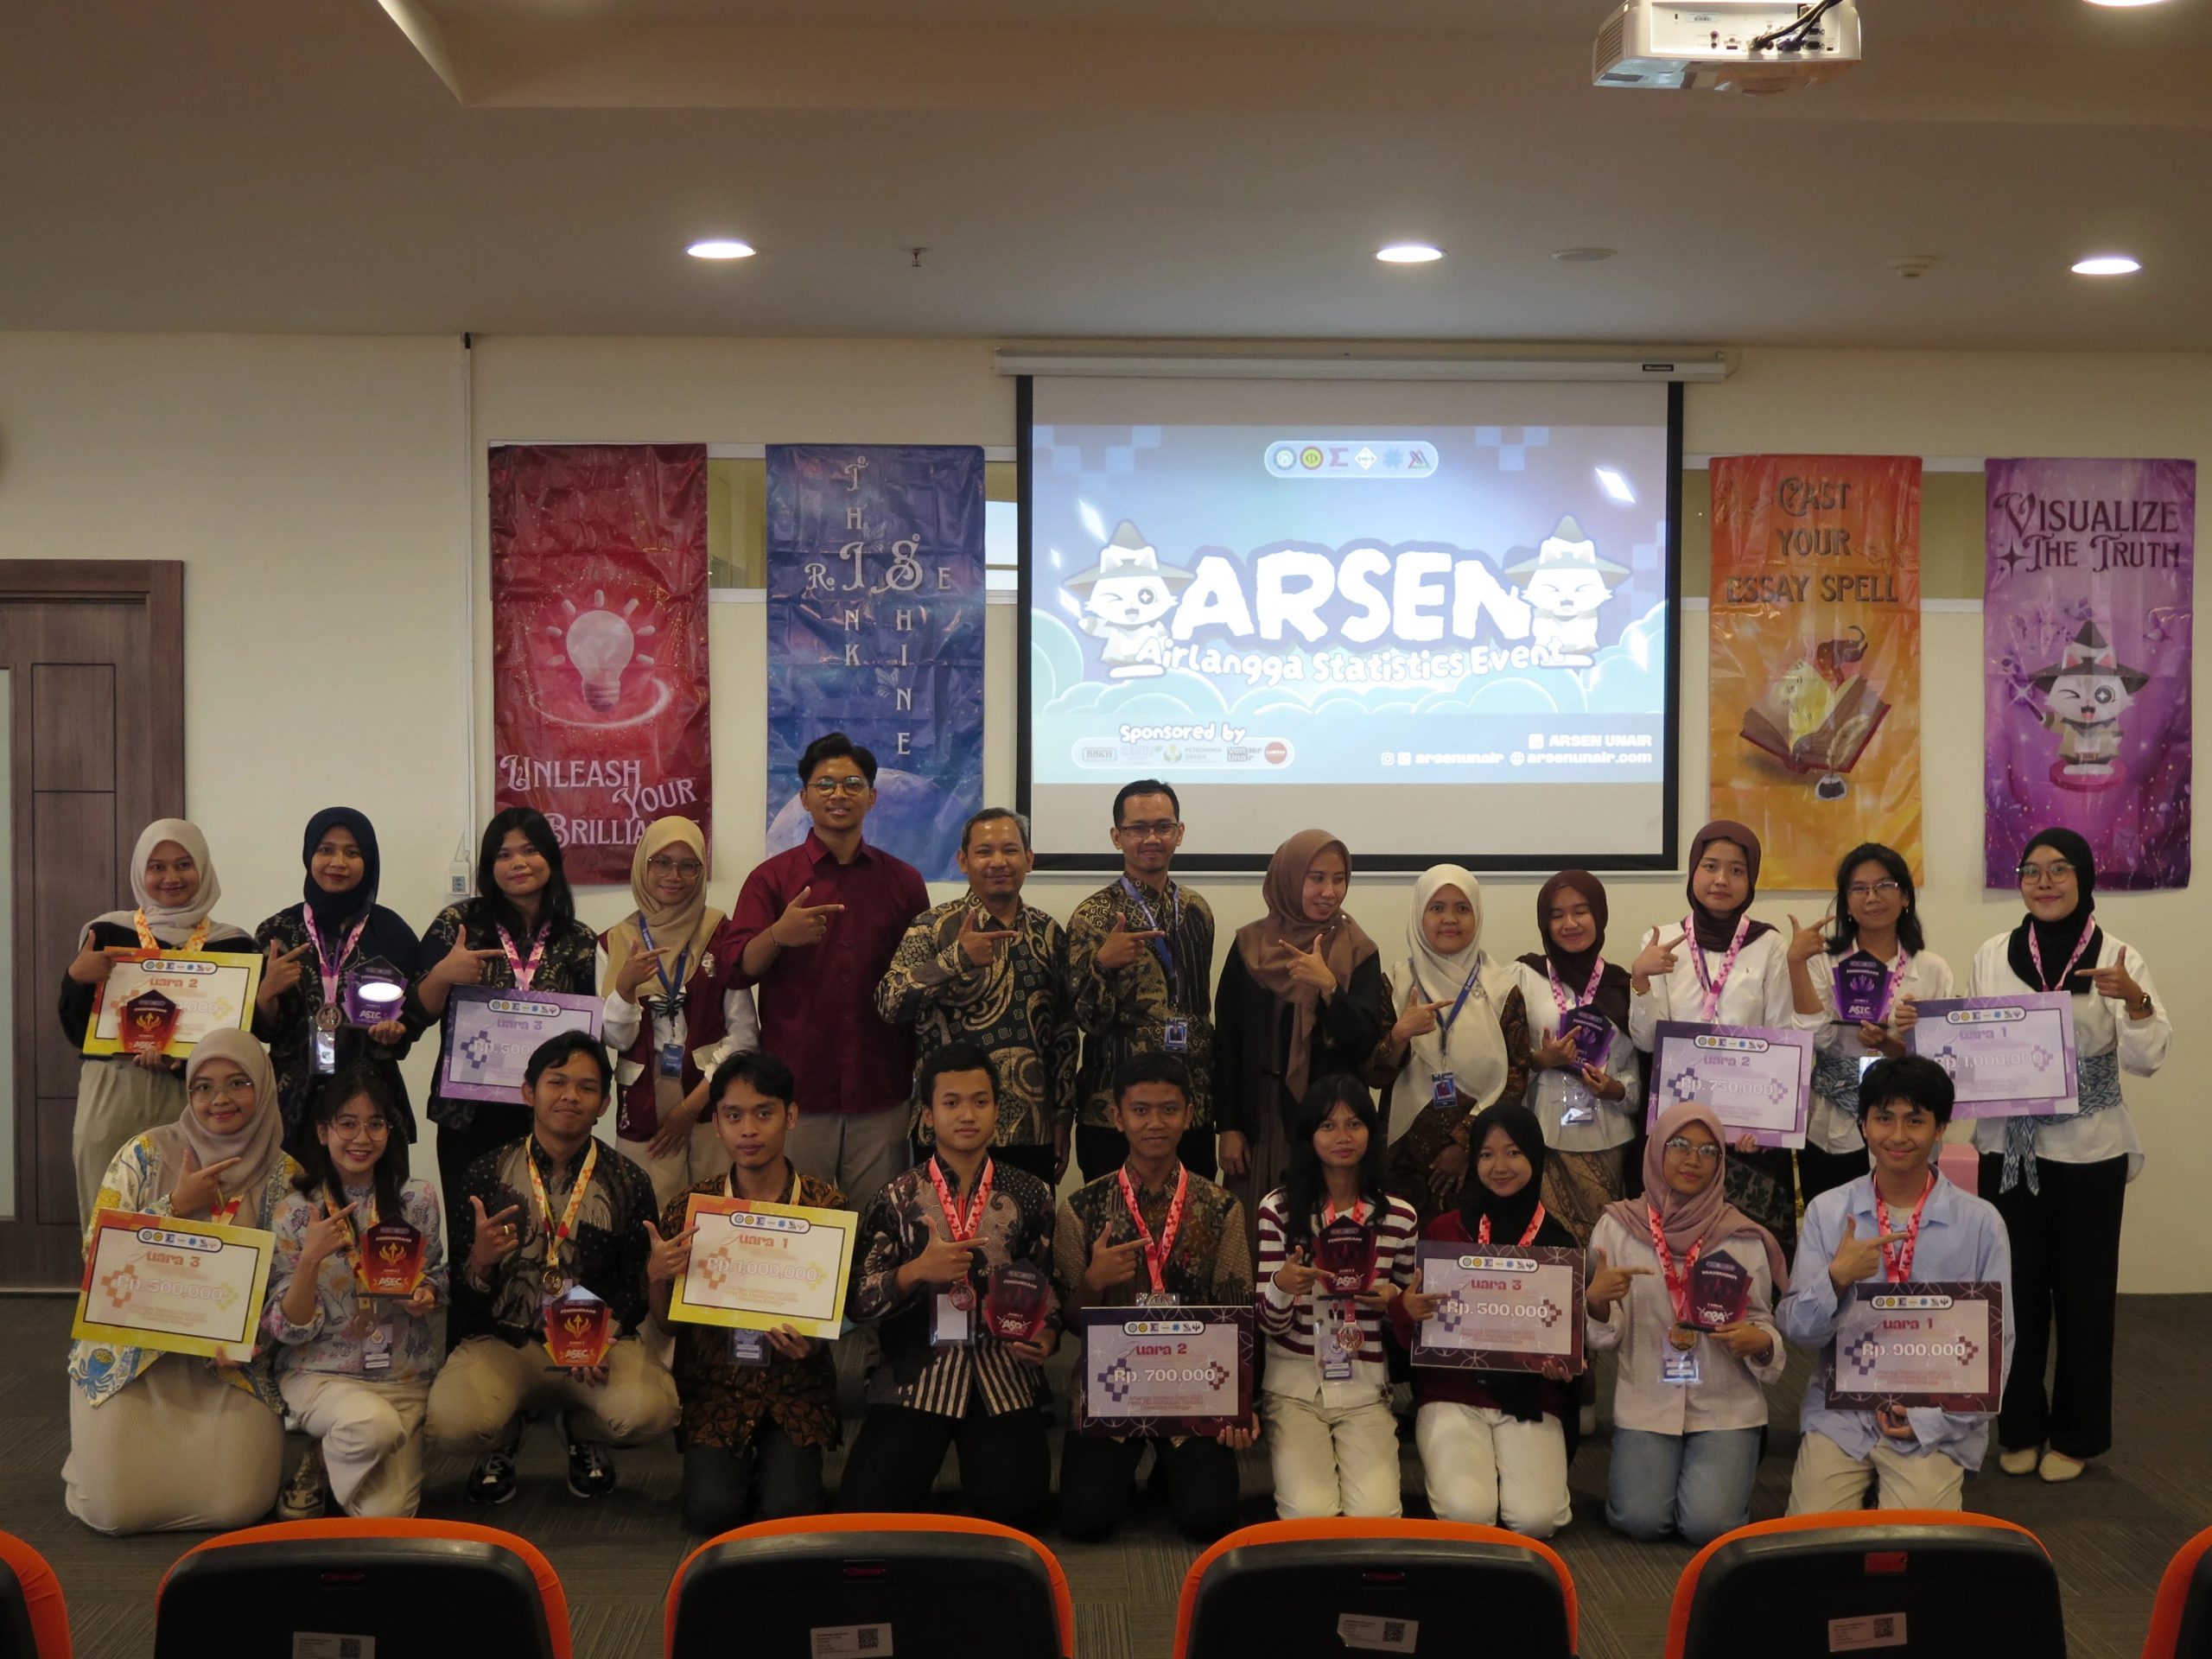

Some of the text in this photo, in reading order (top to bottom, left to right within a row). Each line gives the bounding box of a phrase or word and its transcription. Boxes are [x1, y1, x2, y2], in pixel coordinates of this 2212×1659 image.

[1776, 476, 1850, 517] CAST
[1993, 492, 2179, 537] VISUALIZE
[1777, 528, 1851, 557] YOUR
[2023, 532, 2181, 572] THE TRUTH
[1171, 548, 1532, 643] ARSEN
[1727, 574, 1899, 603] ESSAY SPELL
[1312, 649, 1465, 683] Statistics
[1471, 636, 1567, 676] Event
[1120, 722, 1247, 744] Sponsored by
[1548, 734, 1653, 747] ARSEN UNAIR
[499, 754, 642, 791] UNLEASH
[612, 779, 698, 821] YOUR
[543, 812, 699, 848] BRILLIA
[188, 978, 199, 988] 2
[533, 1020, 543, 1031] 3
[1741, 1056, 1751, 1067] 2
[782, 1237, 789, 1249] 1
[189, 1255, 201, 1268] 3
[1512, 1279, 1522, 1291] 3
[1926, 1318, 1934, 1330] 1
[1177, 1343, 1188, 1355] 2
